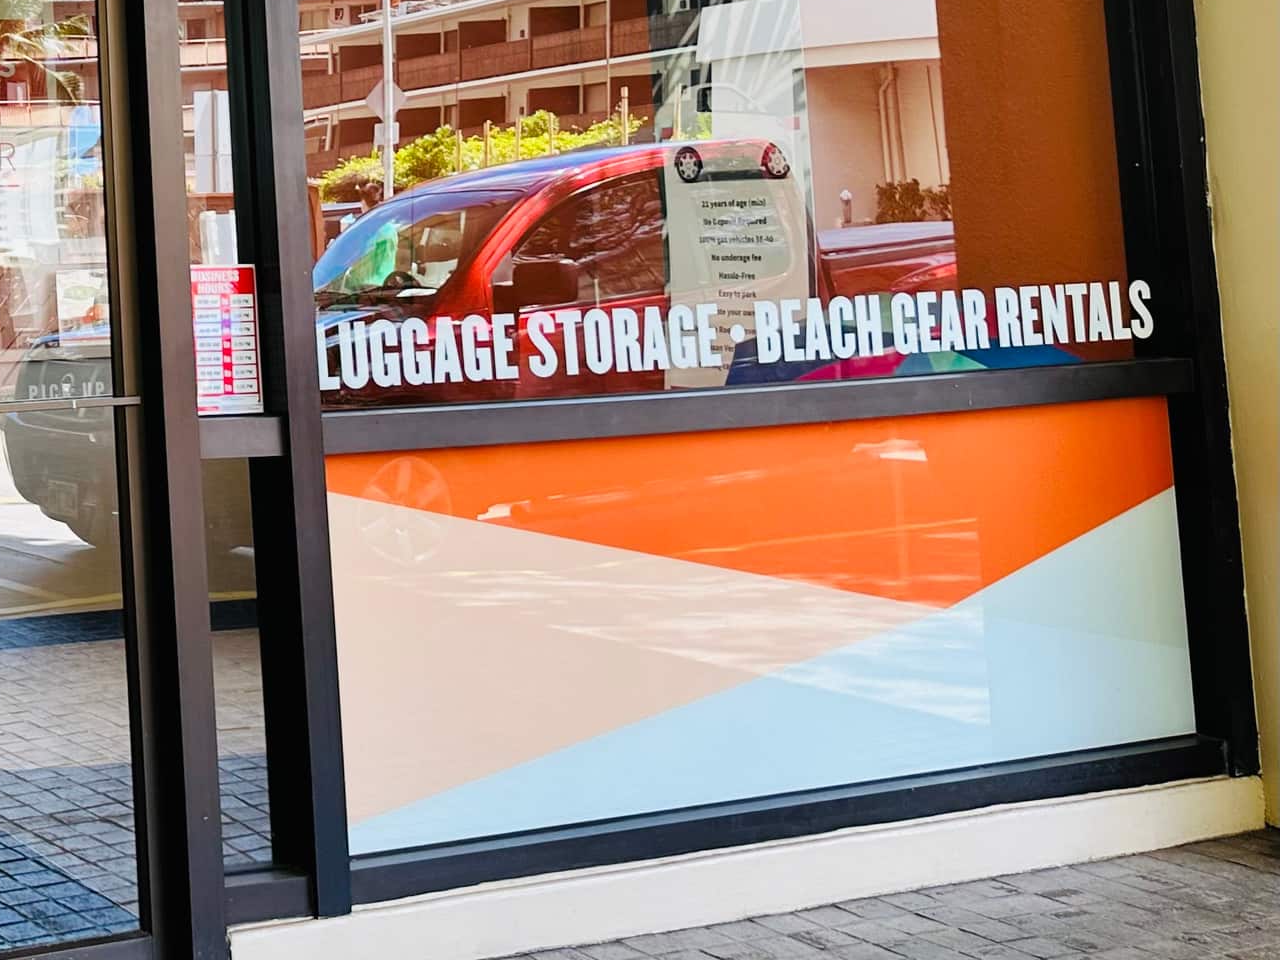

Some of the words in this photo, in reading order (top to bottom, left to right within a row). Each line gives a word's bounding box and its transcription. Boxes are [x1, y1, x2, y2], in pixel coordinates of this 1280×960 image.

[316, 312, 521, 391] LUGGAGE
[526, 303, 722, 378] STORAGE
[754, 295, 882, 365] BEACH
[891, 287, 990, 354] GEAR
[995, 279, 1155, 348] RENTALS
